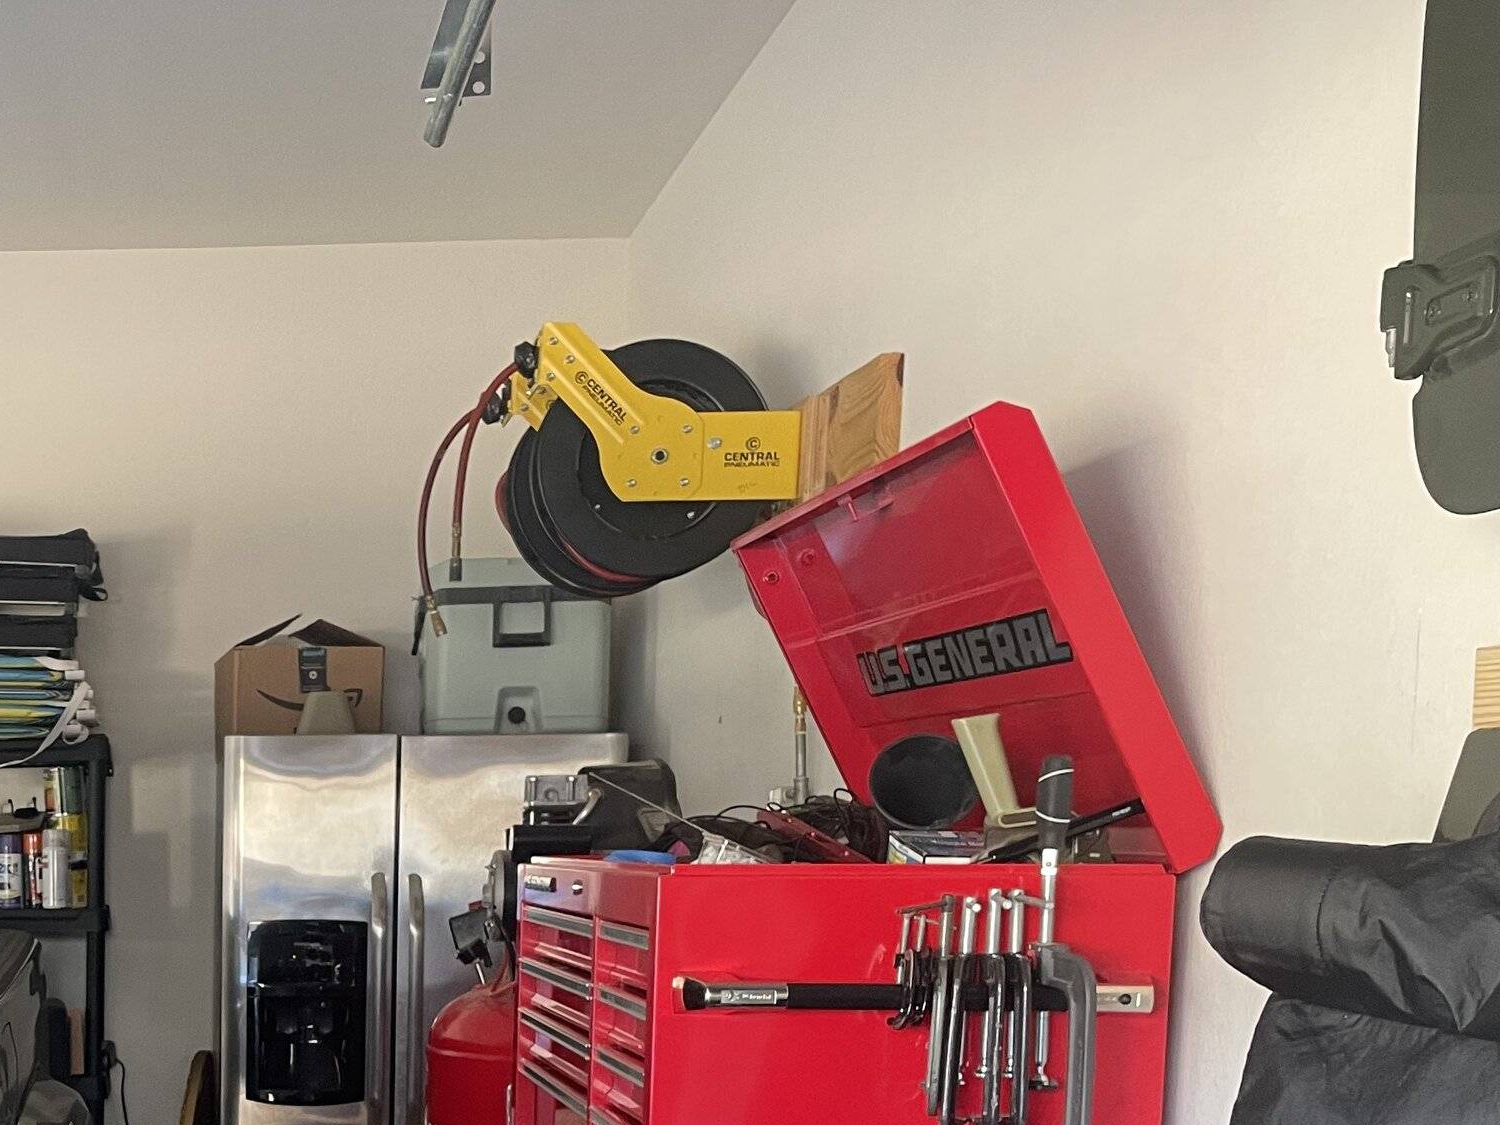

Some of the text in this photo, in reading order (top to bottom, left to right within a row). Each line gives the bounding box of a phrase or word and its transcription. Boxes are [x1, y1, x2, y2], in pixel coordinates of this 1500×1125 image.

[586, 378, 628, 422] CENTRAL
[723, 451, 781, 461] CENTRAL
[905, 614, 1071, 687] GENERAL
